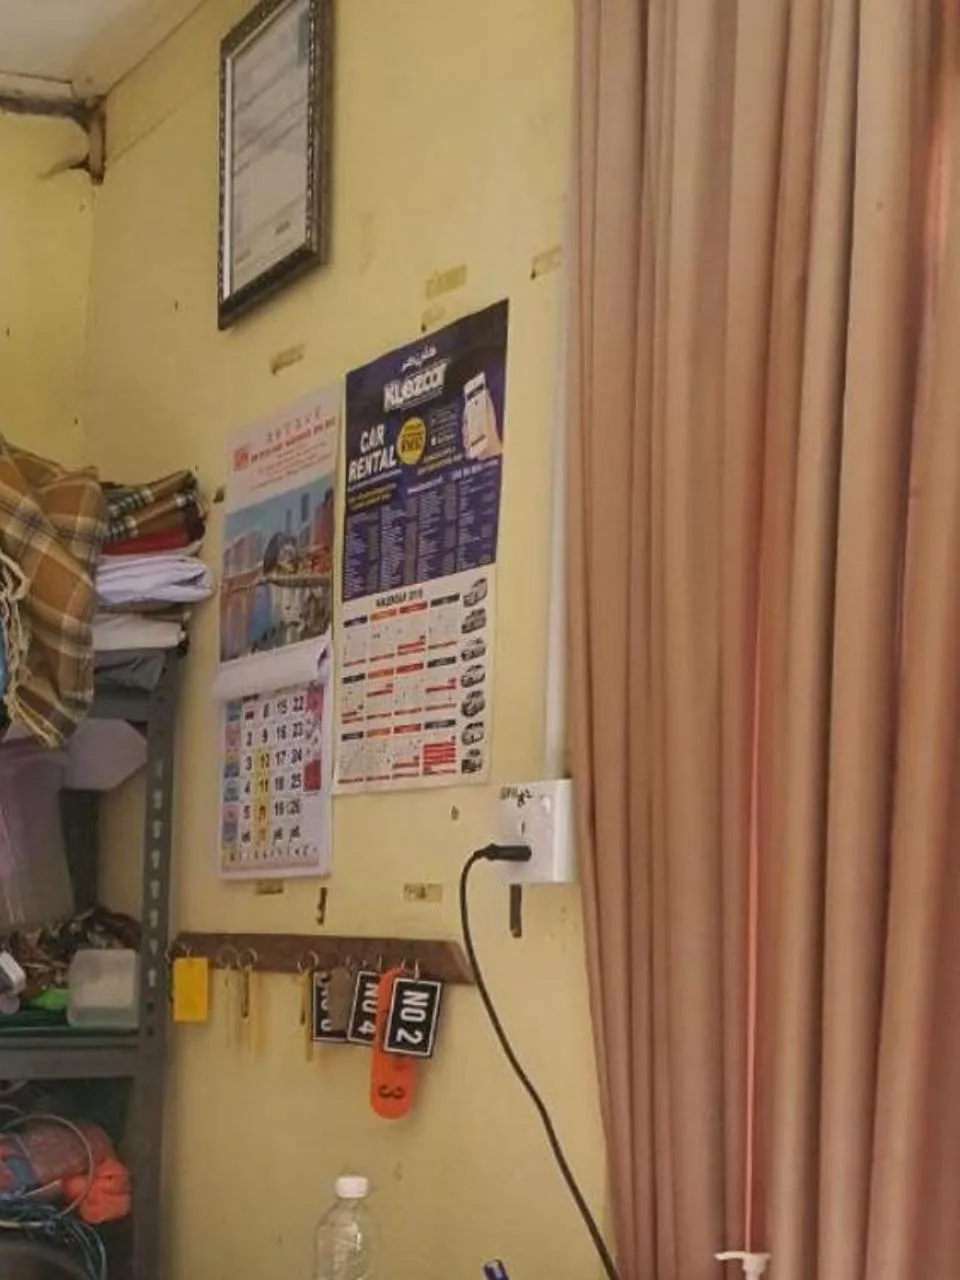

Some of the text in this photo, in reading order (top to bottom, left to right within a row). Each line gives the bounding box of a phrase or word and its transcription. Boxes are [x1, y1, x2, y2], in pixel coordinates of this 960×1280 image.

[360, 423, 385, 454] CAR
[348, 445, 397, 483] RENTAL
[395, 990, 430, 1045] NO 2
[378, 1084, 406, 1100] 3
